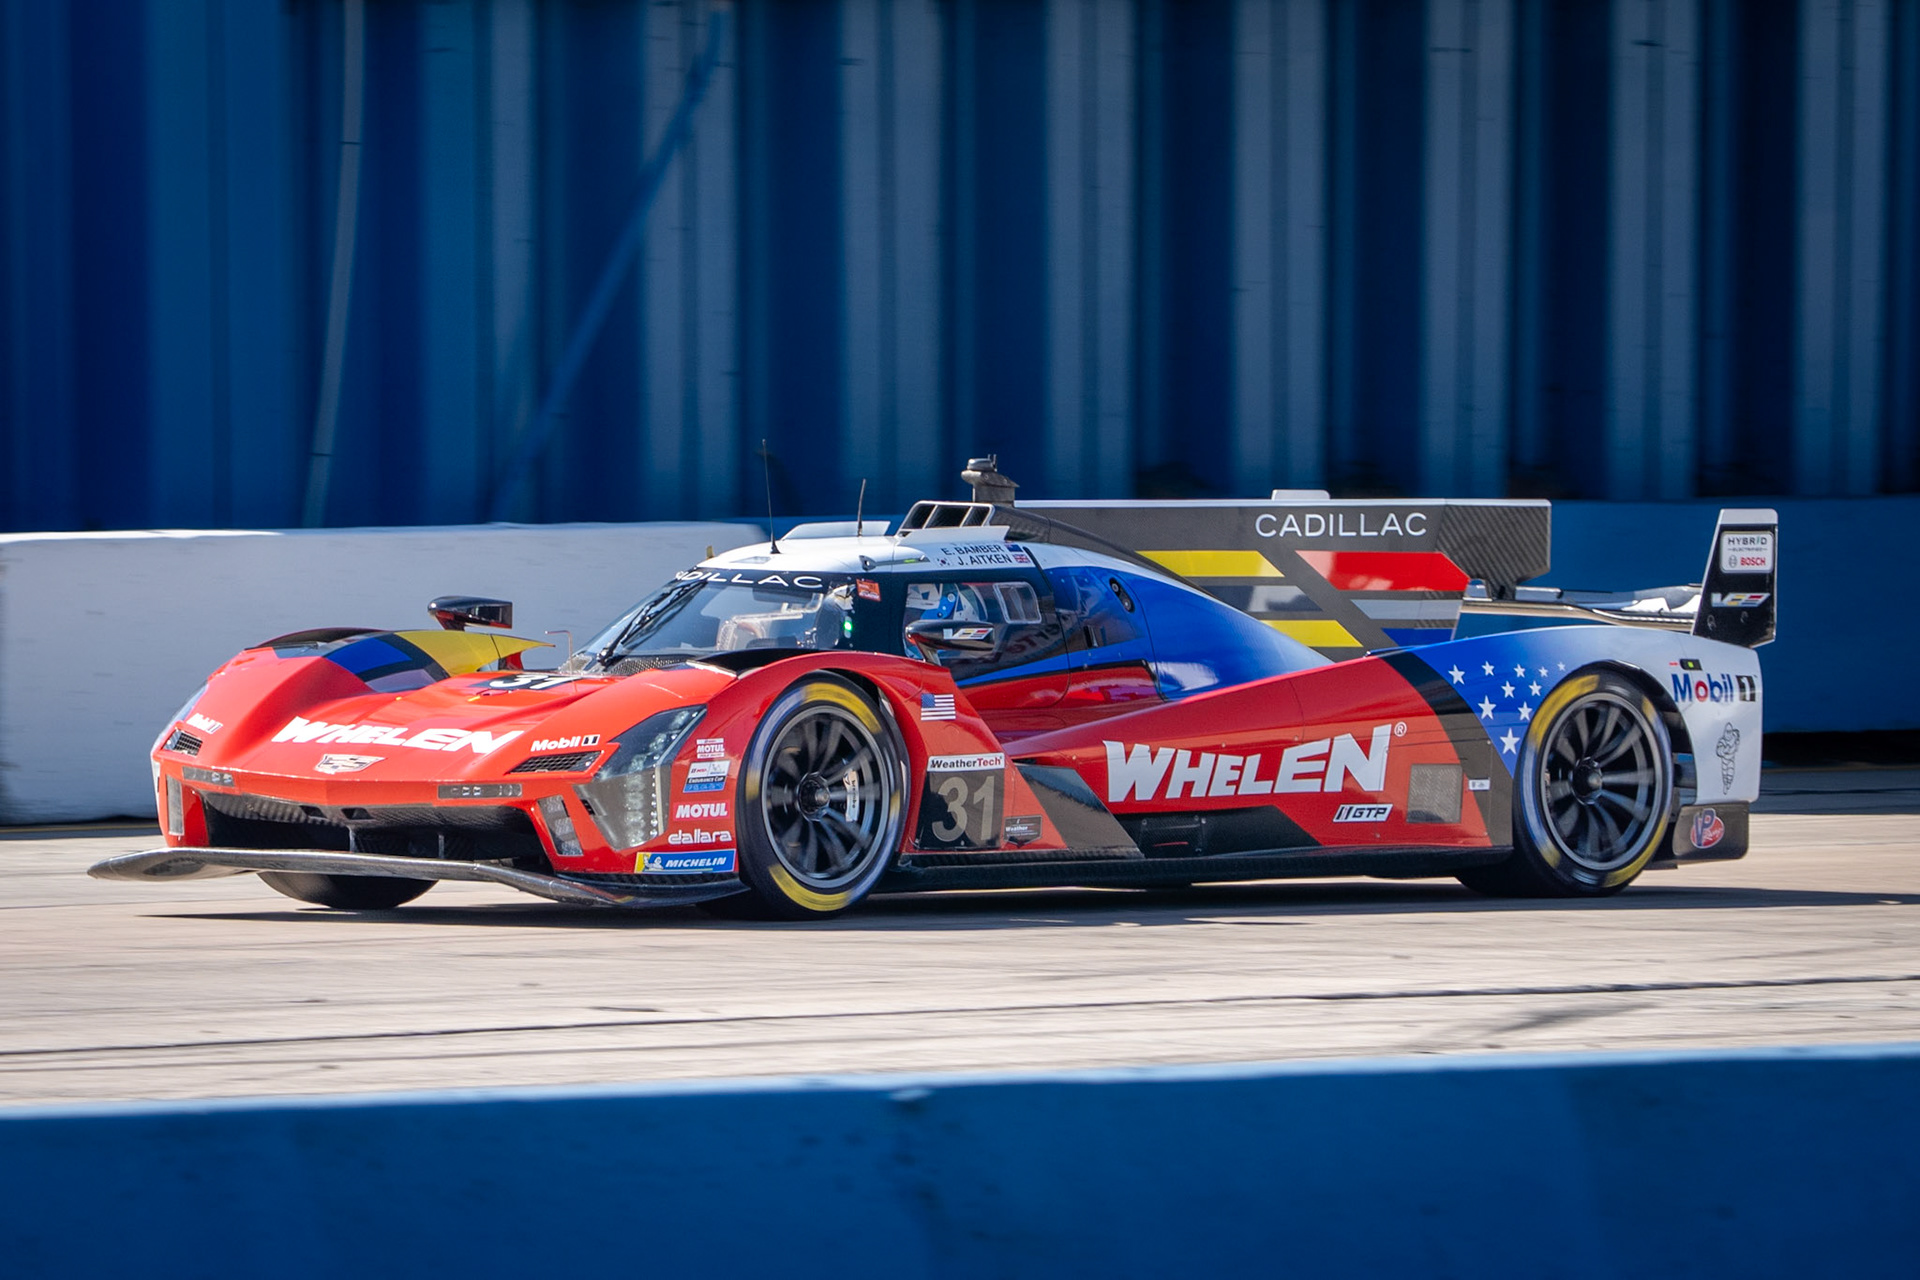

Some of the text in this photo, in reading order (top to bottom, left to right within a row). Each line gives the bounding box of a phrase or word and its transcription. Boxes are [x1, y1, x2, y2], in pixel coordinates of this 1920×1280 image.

[1254, 512, 1428, 538] CADILLAC
[1727, 536, 1768, 546] HYBRID
[941, 544, 1005, 556] E. BAMBER
[957, 553, 1013, 566] J. AITKEN
[1740, 557, 1766, 566] BOSCH
[489, 674, 584, 690] 31
[1671, 673, 1757, 702] Mobil 1
[271, 716, 525, 754] WHELEN
[531, 736, 580, 752] Mobil
[697, 744, 725, 754] MOTUL
[930, 756, 1001, 769] WeatherTech
[1102, 724, 1392, 803] WHELEN
[676, 803, 728, 818] MOTUL
[931, 775, 995, 842] 31
[1352, 807, 1388, 819] GTP
[668, 829, 732, 846] dallara
[665, 856, 727, 869] MICHELIN
